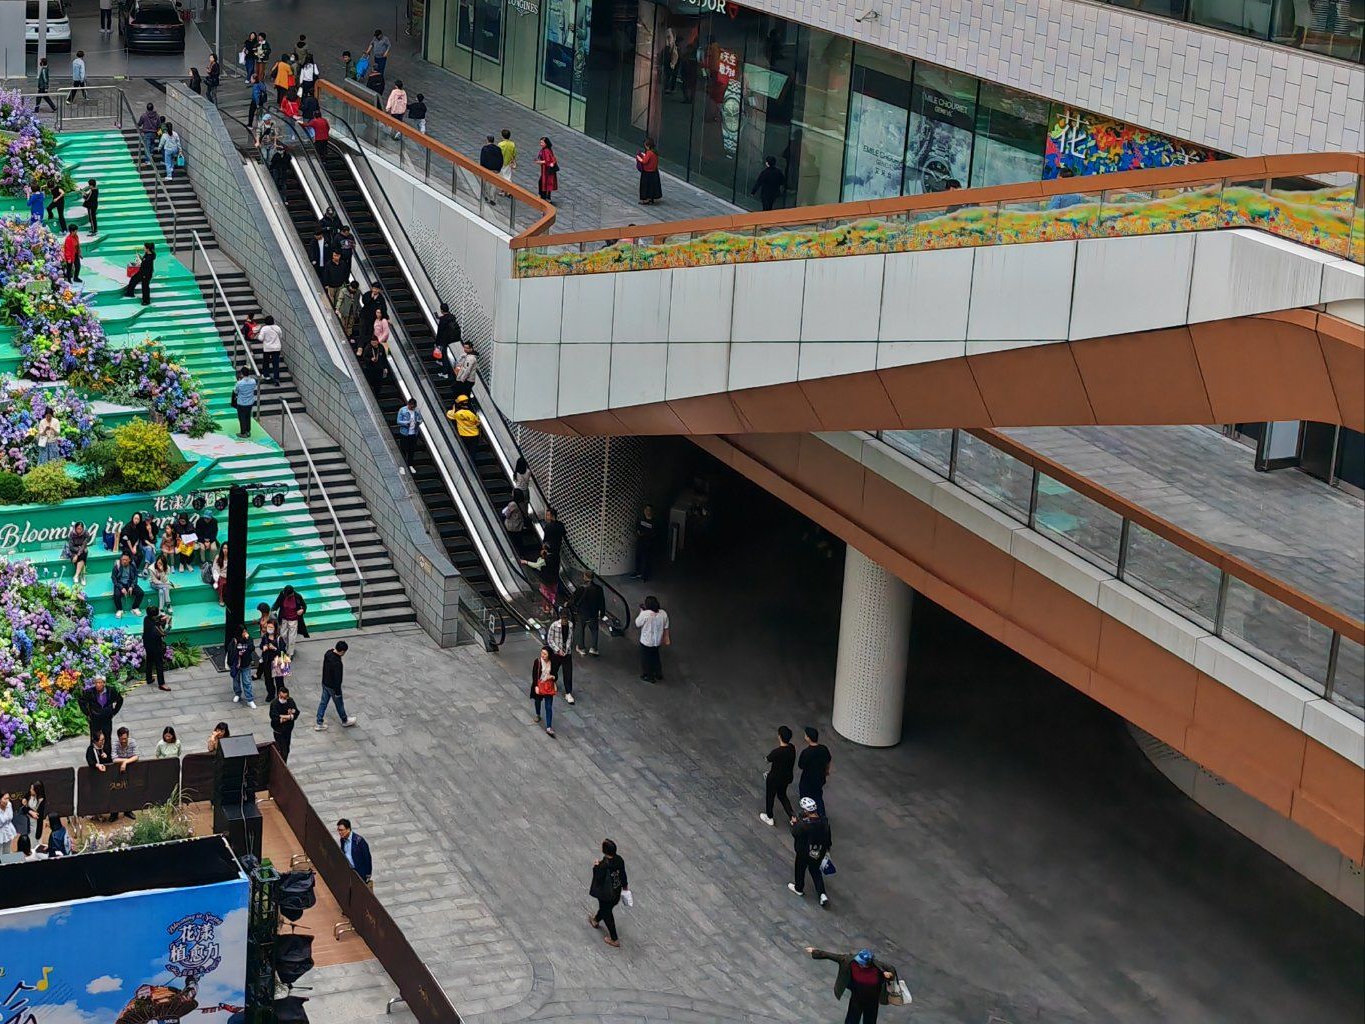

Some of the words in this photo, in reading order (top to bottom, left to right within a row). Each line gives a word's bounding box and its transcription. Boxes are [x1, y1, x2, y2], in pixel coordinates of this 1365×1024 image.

[1057, 110, 1090, 159] 花
[105, 516, 124, 534] in
[178, 922, 215, 943] 花漾
[170, 943, 220, 964] 植愈力
